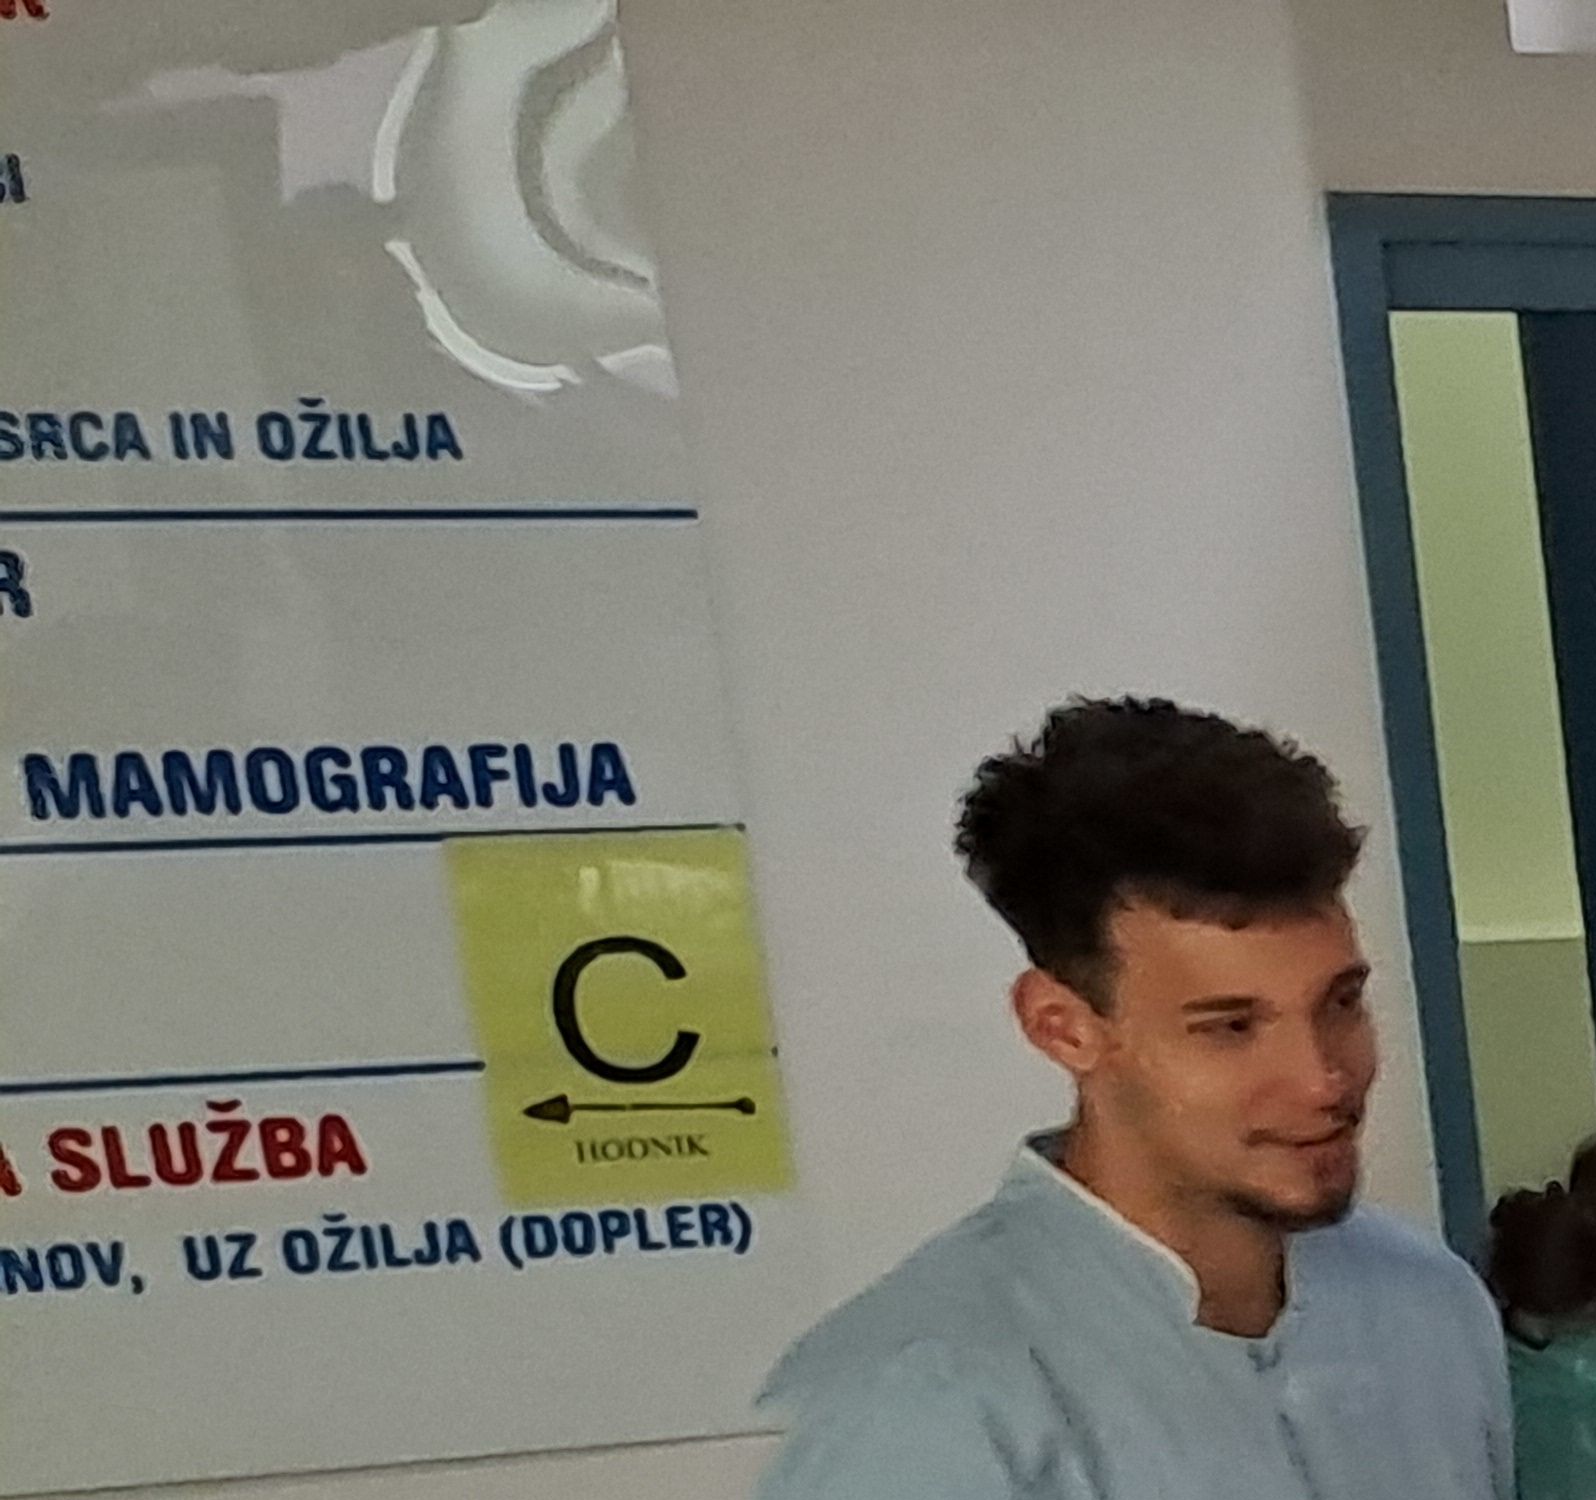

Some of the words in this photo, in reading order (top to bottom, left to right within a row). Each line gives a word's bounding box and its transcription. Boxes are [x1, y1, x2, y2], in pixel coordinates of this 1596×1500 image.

[0, 411, 151, 461] SRCA
[172, 411, 234, 461] IN
[258, 396, 464, 461] OŽILJA
[23, 741, 638, 821] MAMOGRAFIJA
[552, 936, 701, 1084] C
[47, 1100, 367, 1193] SLUŽBA
[574, 1133, 712, 1164] HODNIK
[183, 1233, 263, 1282] UZ
[282, 1214, 482, 1275] OŽILJA
[500, 1202, 753, 1270] (DOPLER)
